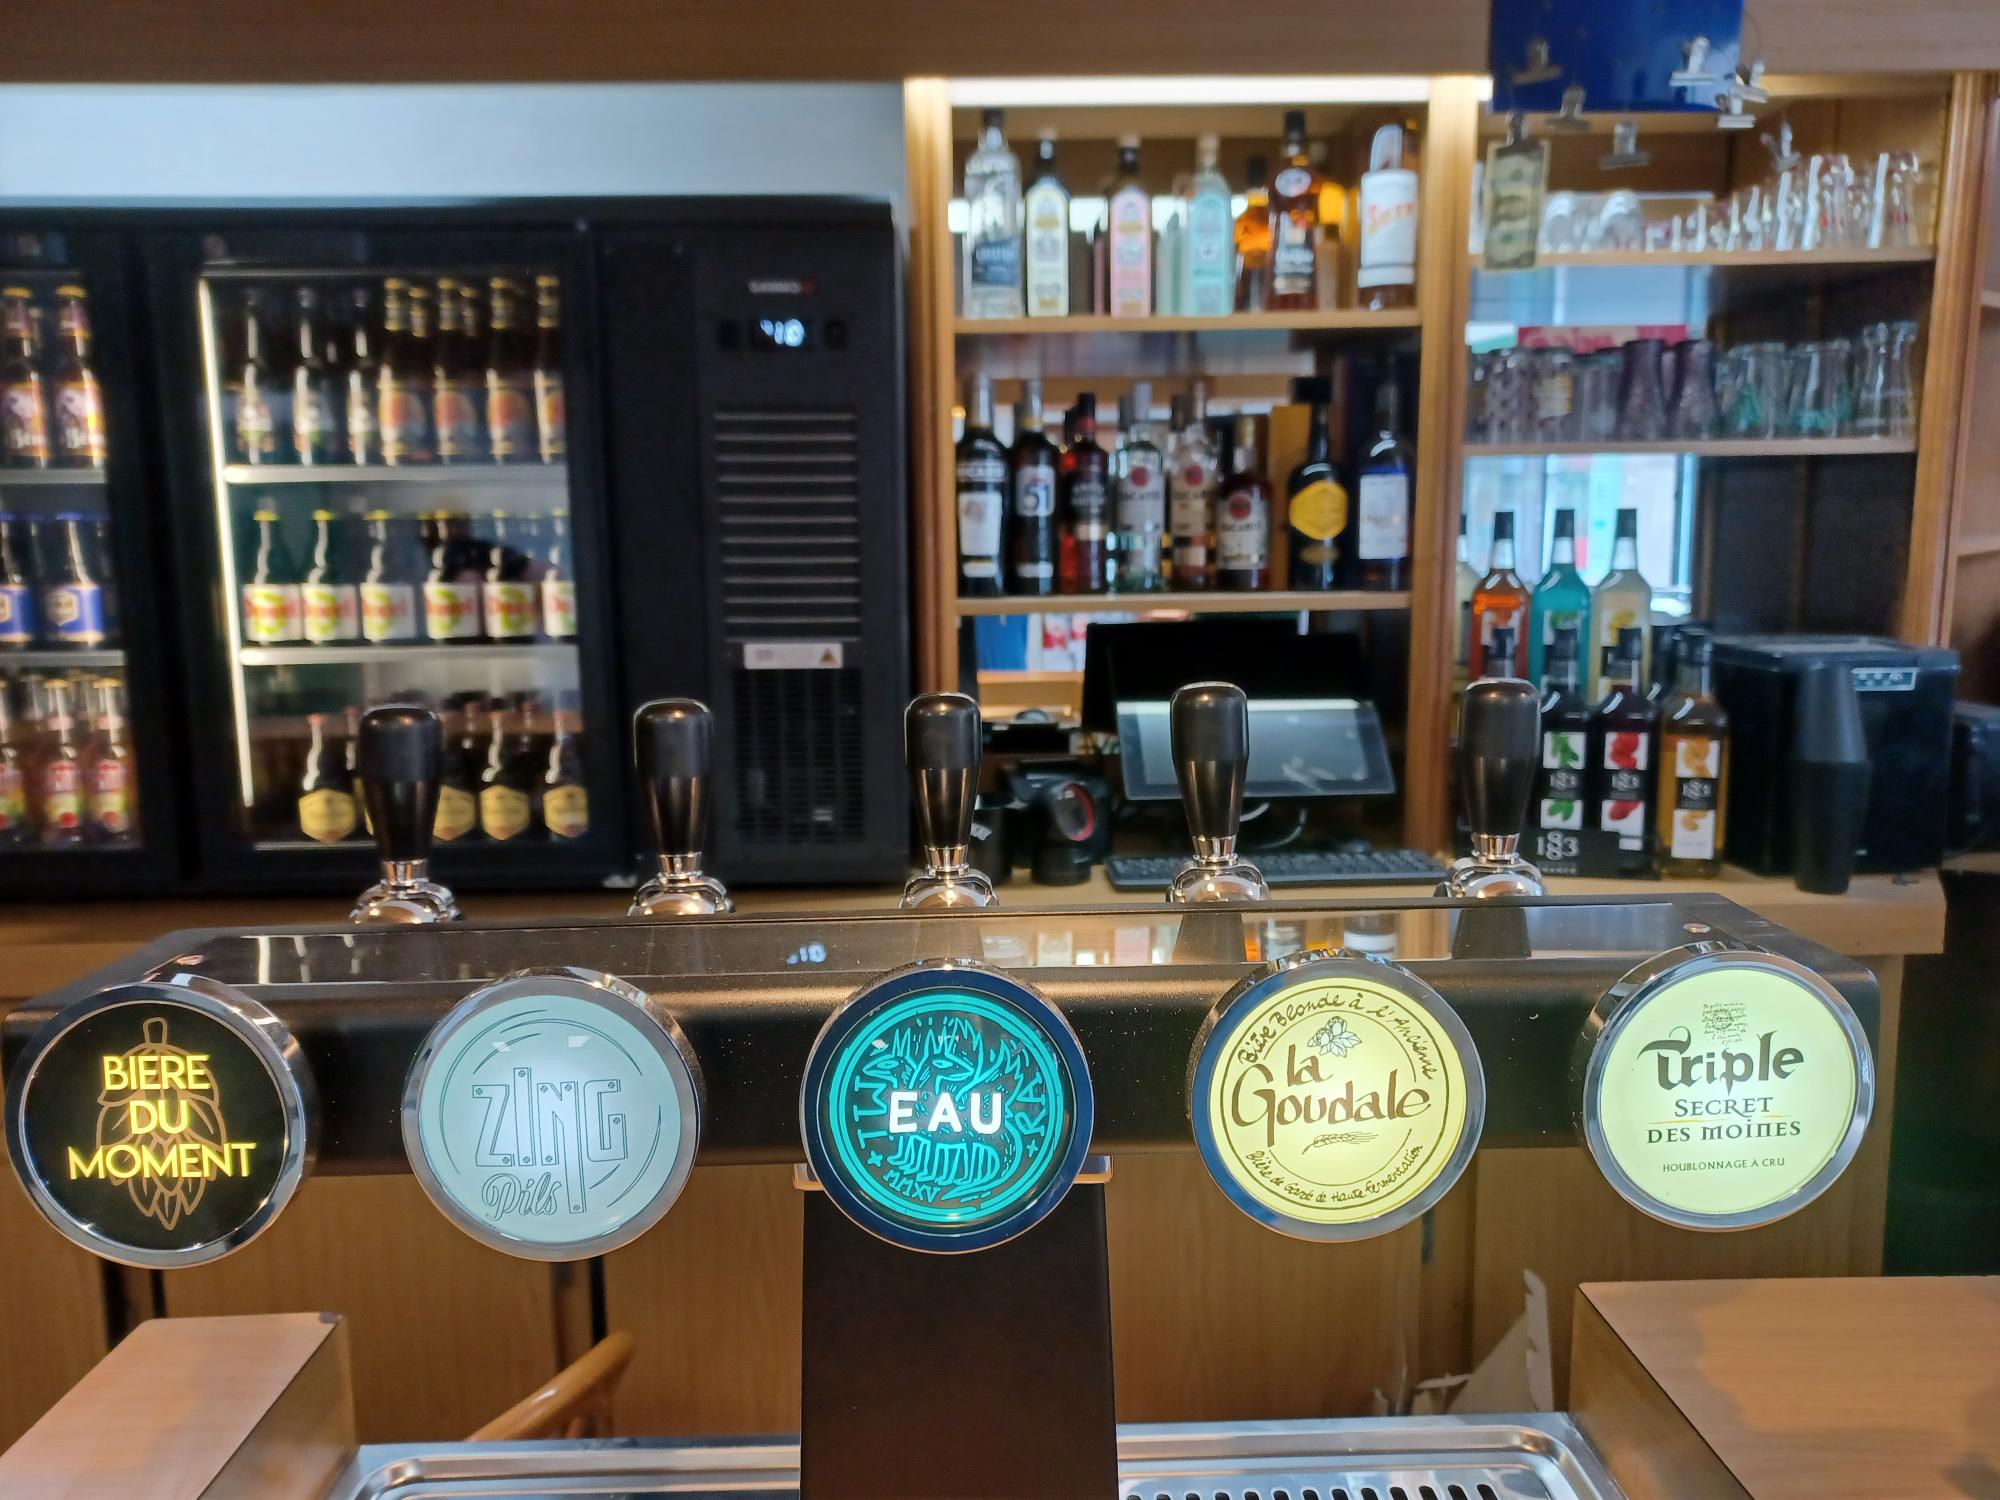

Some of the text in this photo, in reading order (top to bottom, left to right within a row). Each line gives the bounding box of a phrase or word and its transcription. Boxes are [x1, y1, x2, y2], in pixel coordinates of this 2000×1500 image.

[1023, 485, 1050, 512] 51
[1269, 992, 1346, 1027] Blonde
[102, 1054, 211, 1092] BIERE
[1286, 1043, 1335, 1088] la
[1636, 1025, 1805, 1096] Triple
[129, 1099, 190, 1135] DU
[888, 1090, 1004, 1135] EAU
[1230, 1063, 1432, 1149] Goudale
[1674, 1096, 1773, 1118] SECRET
[471, 1065, 626, 1214] ZING
[1646, 1126, 1691, 1144] DES
[67, 1141, 257, 1181] MOMENT
[1662, 1158, 1747, 1173] HOUBLONNAGE
[1761, 1157, 1786, 1168] CRU
[481, 1171, 560, 1222] Pils
[882, 1168, 941, 1203] MMXV
[1331, 1188, 1367, 1202] Haute
